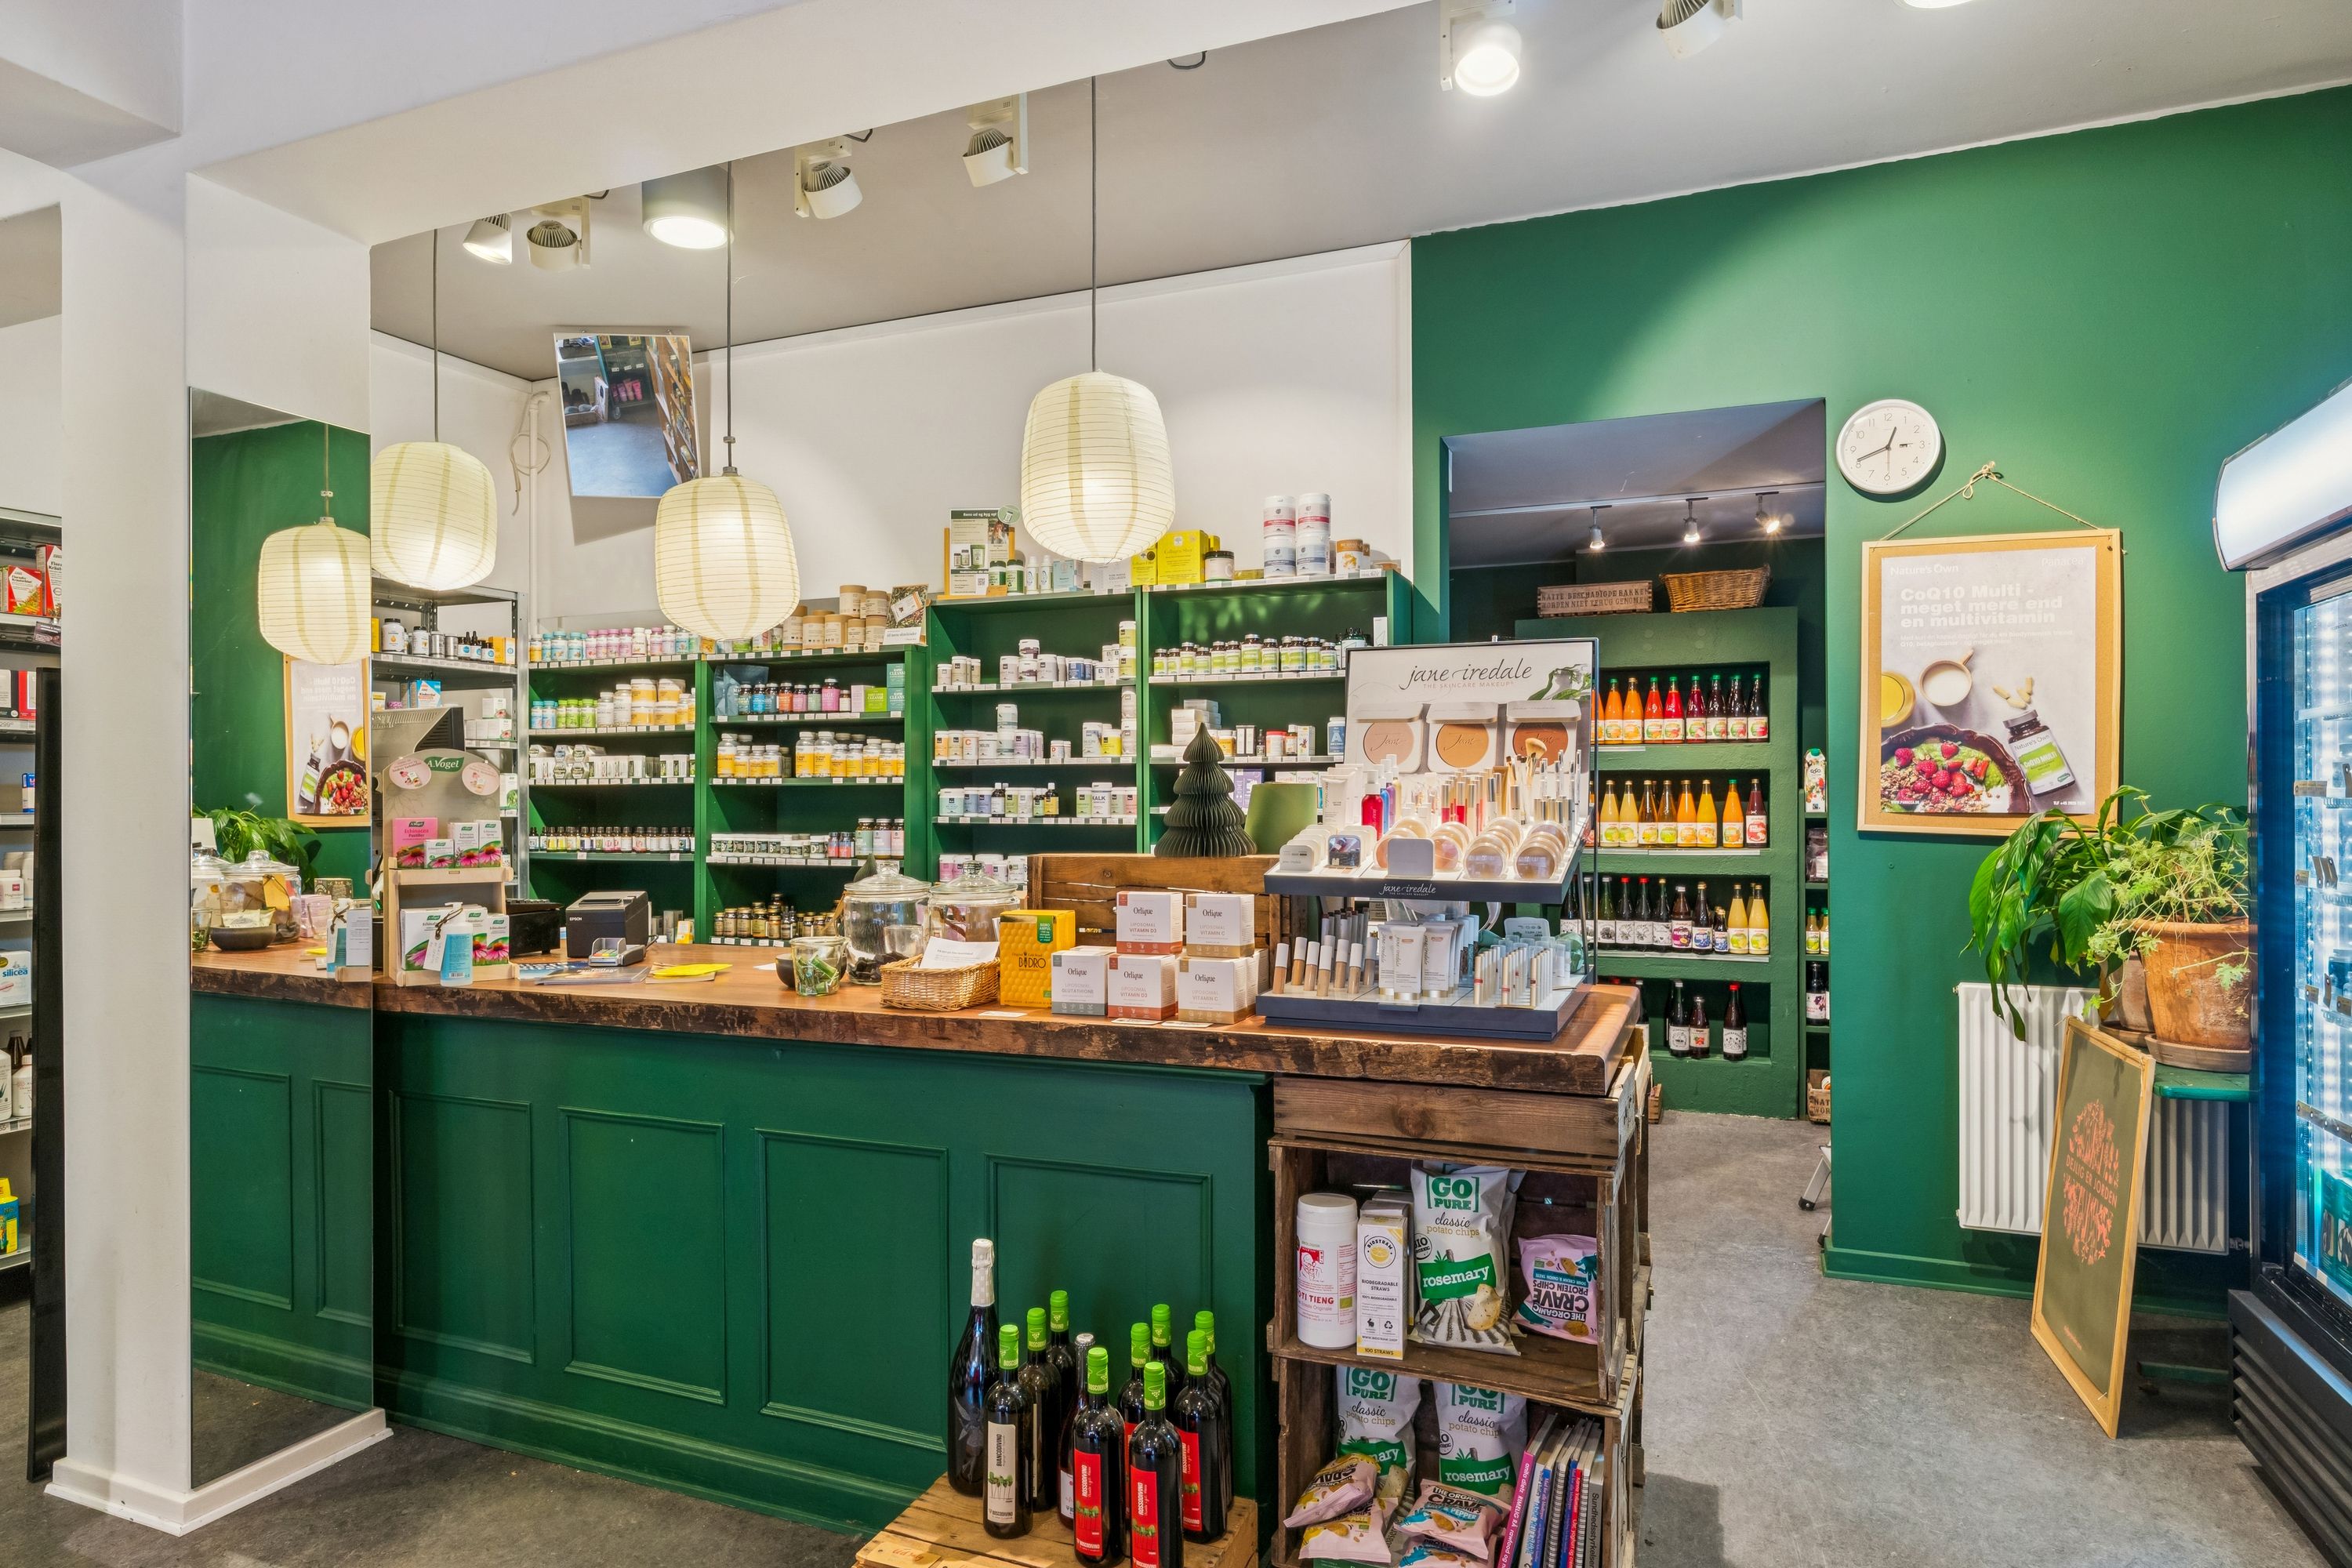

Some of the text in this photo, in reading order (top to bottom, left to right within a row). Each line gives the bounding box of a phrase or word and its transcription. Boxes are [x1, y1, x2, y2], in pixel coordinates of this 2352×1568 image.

[1914, 425, 1920, 434] 2
[1850, 445, 1857, 454] 9
[1884, 472, 1890, 481] 6
[1890, 563, 1959, 576] Nature's Own
[1900, 586, 1965, 601] CoQ10
[1972, 583, 2021, 599] Multi
[1900, 596, 2063, 616] meget mere end
[1900, 611, 2056, 628] en multivitamin
[1399, 658, 1532, 690] jane iredale
[2014, 738, 2037, 750] Nature's
[427, 760, 459, 770] A.Vogel
[1379, 884, 1436, 895] jane iredale
[1133, 907, 1153, 916] Orlique
[1203, 909, 1222, 918] Orlique
[2, 967, 28, 978] silicea
[1068, 967, 1087, 977] Orlique
[1123, 971, 1143, 980] Orlique
[1195, 974, 1216, 983] Orlique
[2066, 1154, 2118, 1208] DEJLIG ER JORDEN
[1432, 1177, 1472, 1199] GO
[1434, 1197, 1472, 1210] PURE
[1435, 1212, 1470, 1228] classic
[1427, 1225, 1479, 1237] potato chips
[1367, 1239, 1393, 1250] BIOSTRAW
[1423, 1265, 1490, 1287] rosemary
[1361, 1279, 1399, 1287] BIODEGRADABLE
[1533, 1279, 1588, 1295] PROTEIN CHIPS
[1309, 1295, 1334, 1305] TIENG
[1533, 1288, 1589, 1312] CRAVE
[1531, 1303, 1585, 1321] THE ORGANIC
[1351, 1367, 1391, 1392] GO
[1352, 1388, 1388, 1400] PURE
[1352, 1401, 1386, 1417] classic
[1459, 1396, 1497, 1411] PURE
[1371, 1417, 1396, 1427] chips
[1458, 1410, 1495, 1428] classic
[1448, 1421, 1501, 1439] potato chip
[1445, 1465, 1511, 1483] rosemary
[1434, 1486, 1479, 1503] THE ORGAN
[1450, 1508, 1477, 1520] PEPPER
[1513, 1495, 1523, 1521] RIMELIG
[1504, 1529, 1514, 1555] rawfood
